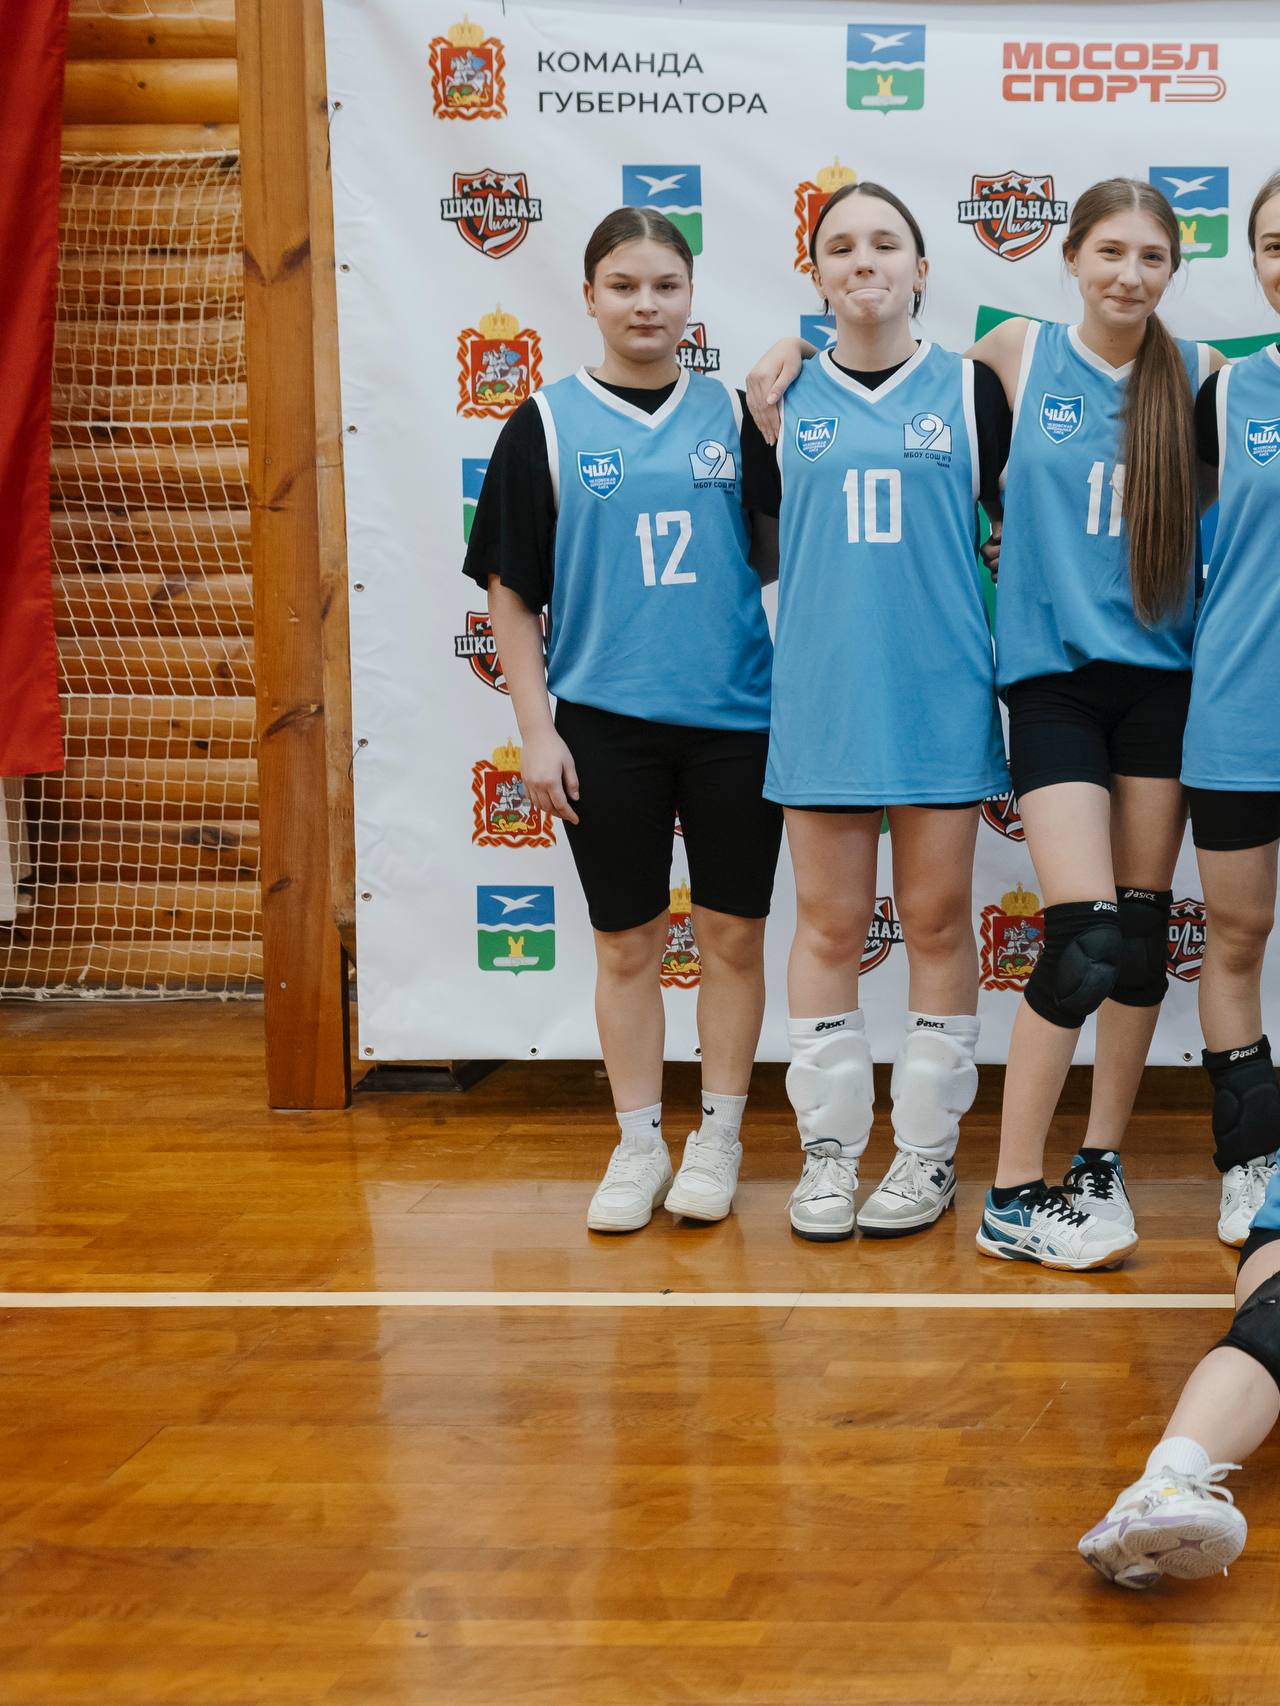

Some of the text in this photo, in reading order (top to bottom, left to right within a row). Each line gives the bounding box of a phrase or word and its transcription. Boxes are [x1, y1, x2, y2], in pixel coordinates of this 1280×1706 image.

[537, 50, 705, 78] КОМАНДА
[1002, 42, 1219, 71] МОСОБЛ
[1002, 74, 1173, 103] СПОРТ
[538, 90, 769, 115] ГУБЕРНАТОРА
[442, 194, 541, 219] ШКОЛЬНАЯ
[959, 196, 1067, 222] ШКОЛЬНАЯ
[1045, 408, 1078, 423] ЧШЛ
[800, 428, 831, 441] ЧШЛ
[1249, 431, 1280, 445] ЧШЛ
[582, 463, 620, 477] ЧШЛ
[842, 468, 902, 544] 10
[1086, 461, 1127, 537] 11
[635, 510, 697, 587] 12
